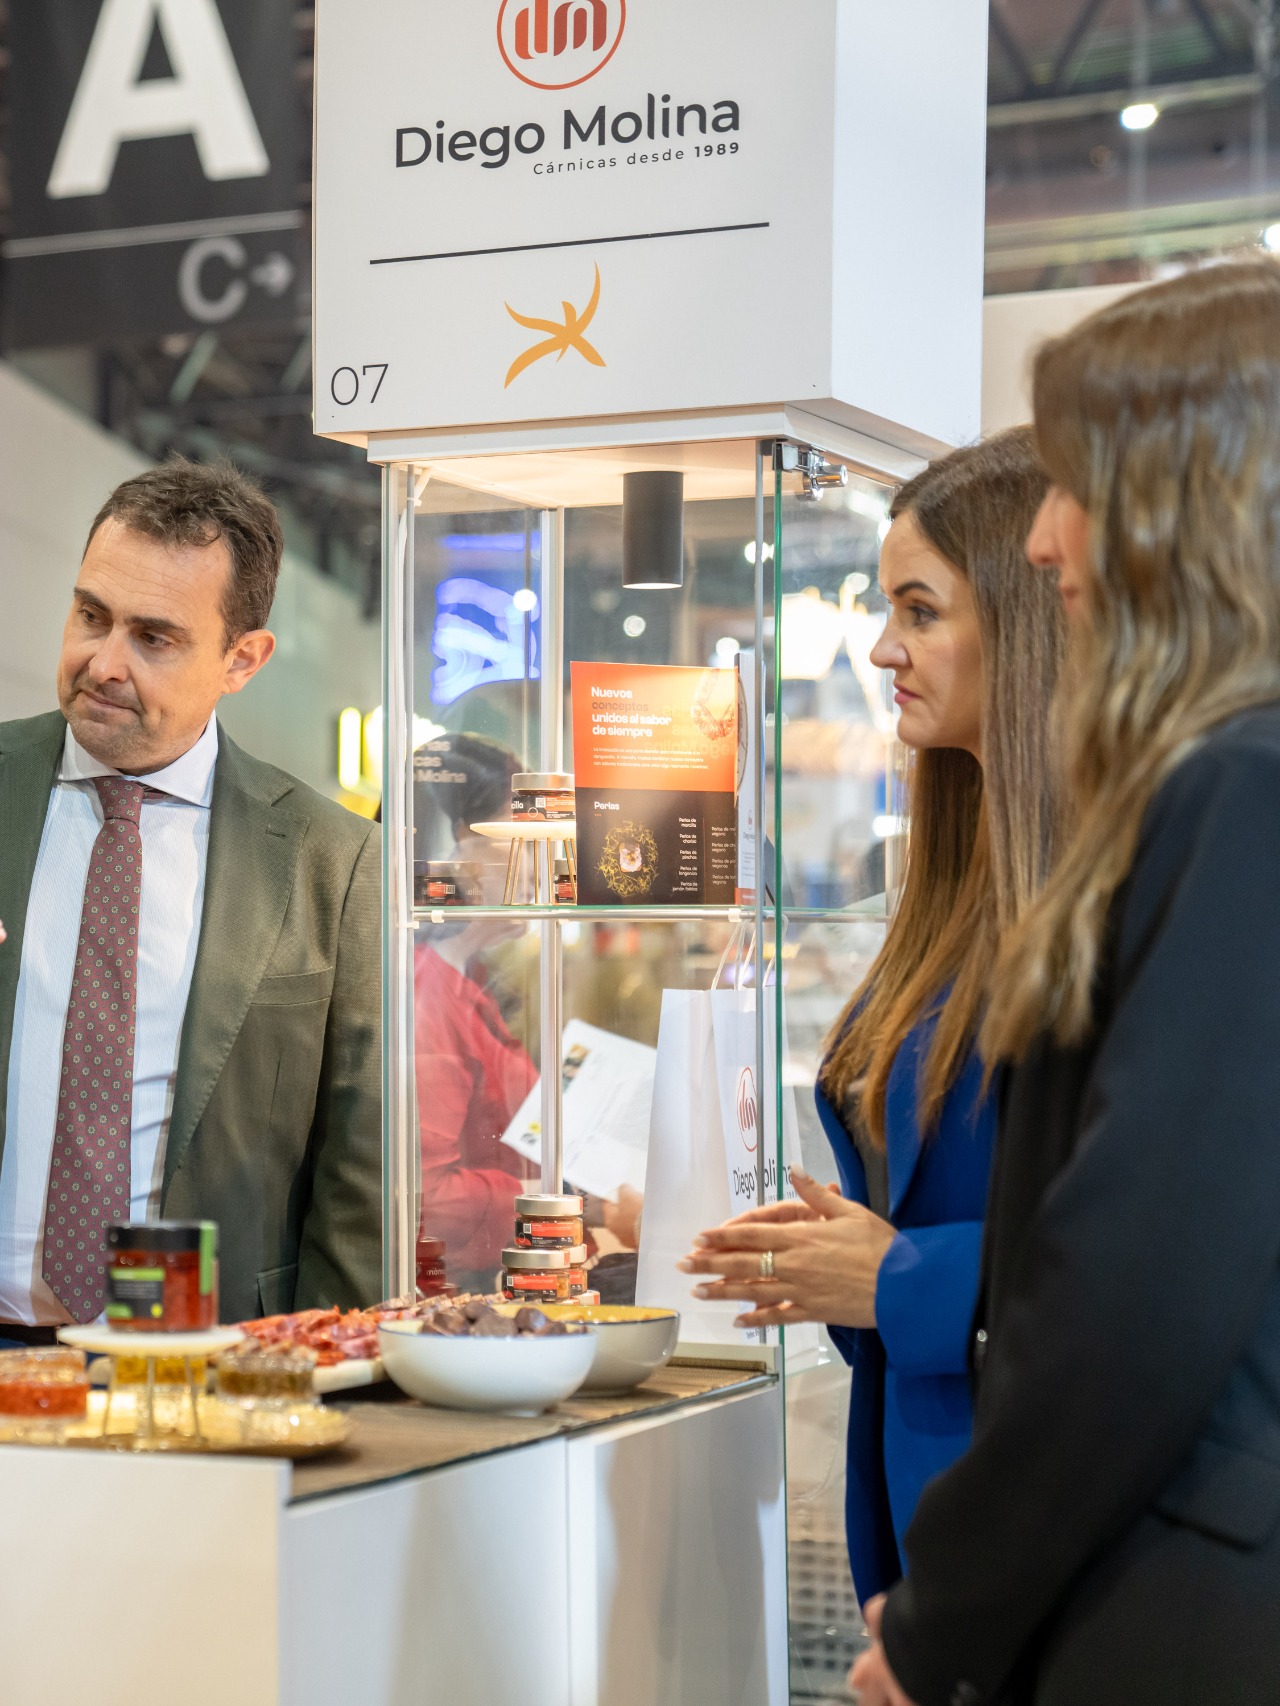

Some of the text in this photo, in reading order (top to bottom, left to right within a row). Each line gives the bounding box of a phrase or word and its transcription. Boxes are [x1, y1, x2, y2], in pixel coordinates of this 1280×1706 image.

[46, 0, 270, 199] A
[396, 93, 740, 169] Diego Molina
[533, 142, 740, 175] Cárnicas desde 1989
[179, 236, 247, 323] C
[330, 363, 389, 406] 07
[591, 686, 633, 699] Nuevos
[592, 701, 649, 713] conceptos
[591, 712, 672, 725] unidos al sabor
[592, 725, 653, 739] de siempre
[594, 801, 620, 811] Perlas
[733, 1158, 793, 1199] Diego olina
